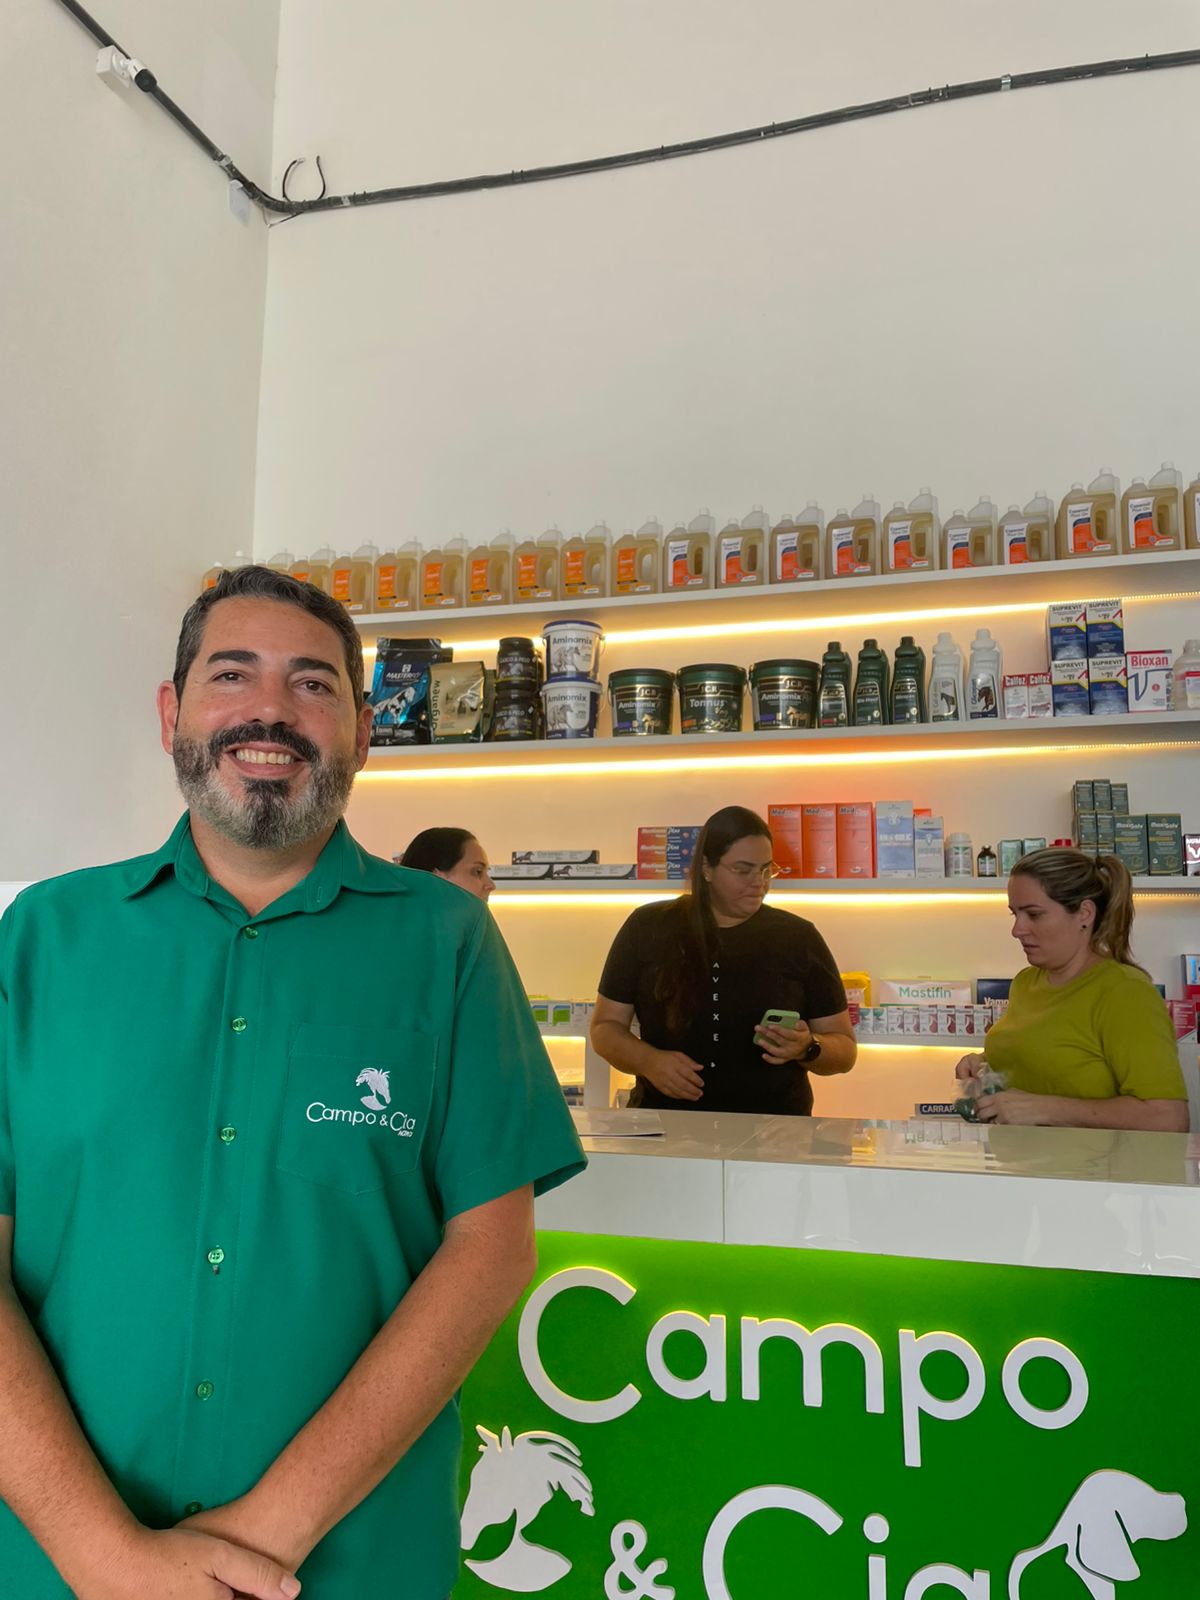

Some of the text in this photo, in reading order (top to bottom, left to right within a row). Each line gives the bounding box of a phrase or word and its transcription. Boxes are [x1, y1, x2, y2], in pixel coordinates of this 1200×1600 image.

[552, 635, 593, 645] Aminomix
[1053, 661, 1084, 669] SUPREVIT
[1091, 659, 1123, 667] SUPREVIT
[1131, 655, 1169, 667] Bioxan
[548, 693, 587, 702] Aminomix
[761, 692, 800, 701] Aminomix
[898, 987, 952, 999] Mastifin
[922, 1104, 958, 1113] CARRAP
[306, 1101, 416, 1131] Campo & Cia
[518, 1265, 1090, 1468] Campo
[603, 1518, 676, 1600] &
